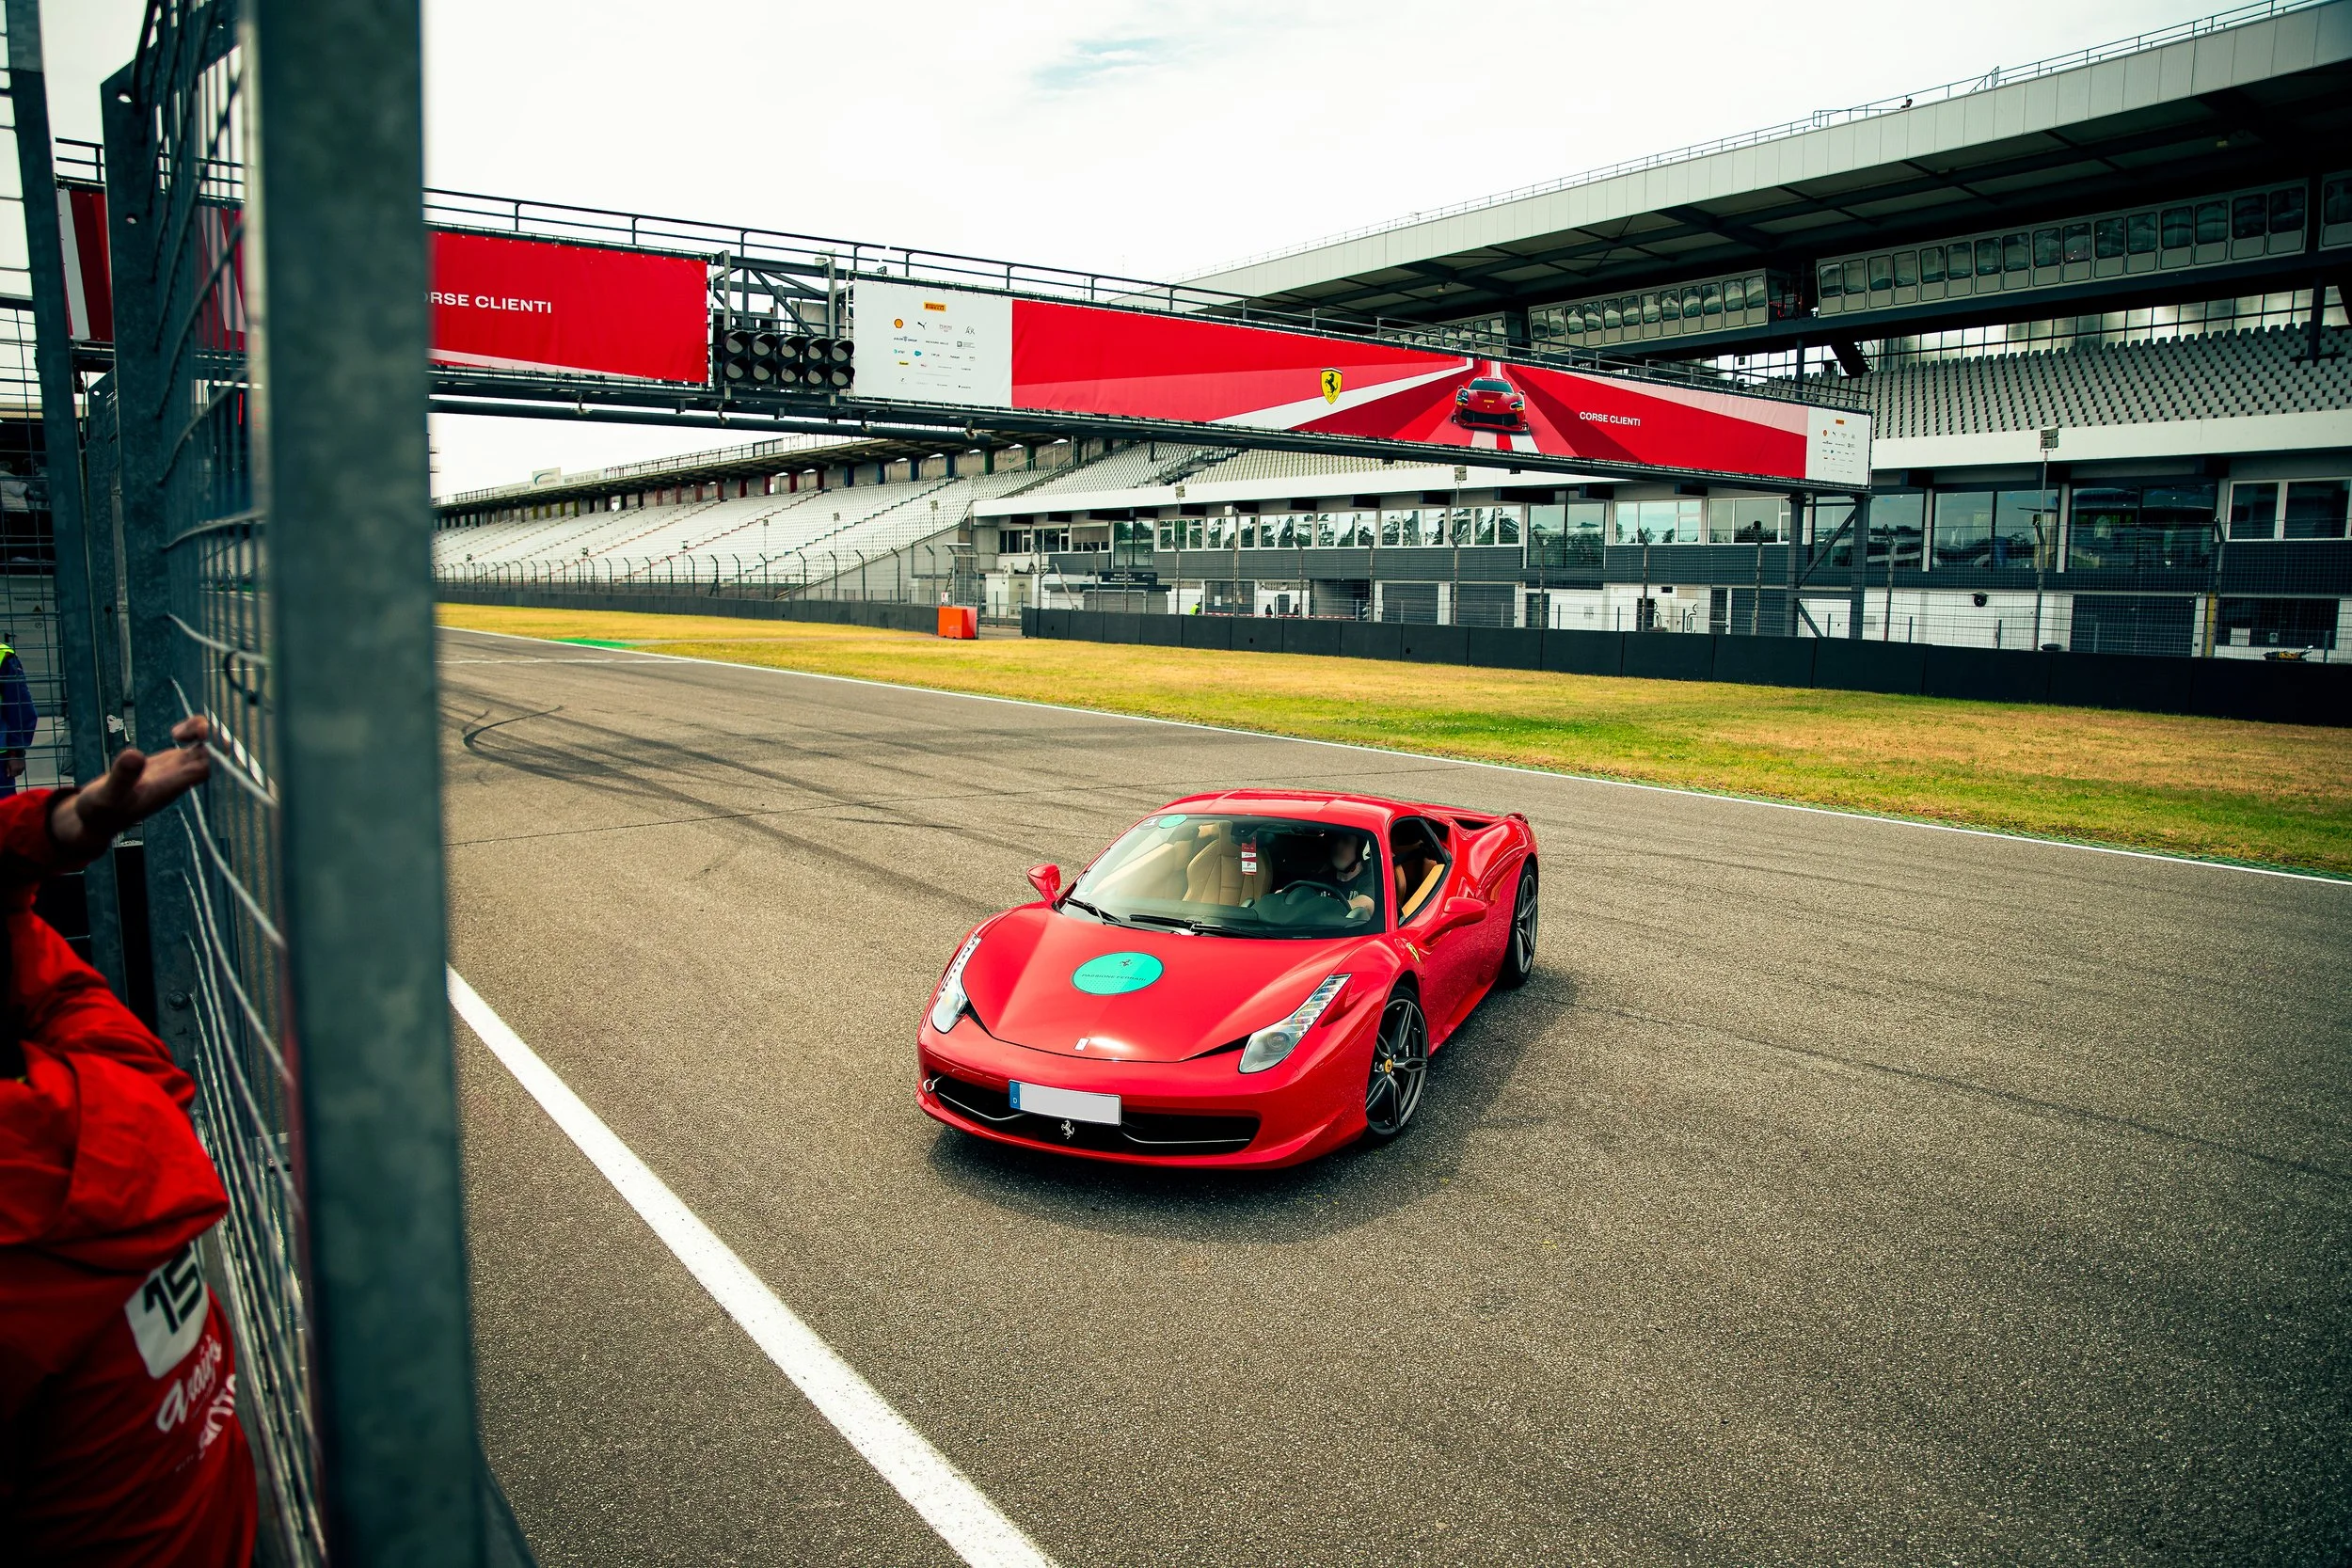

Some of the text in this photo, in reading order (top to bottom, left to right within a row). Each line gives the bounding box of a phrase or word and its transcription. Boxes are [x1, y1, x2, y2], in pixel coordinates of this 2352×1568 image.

[474, 294, 552, 314] CLIENTI
[1580, 411, 1641, 426] CORSE CLIENTI
